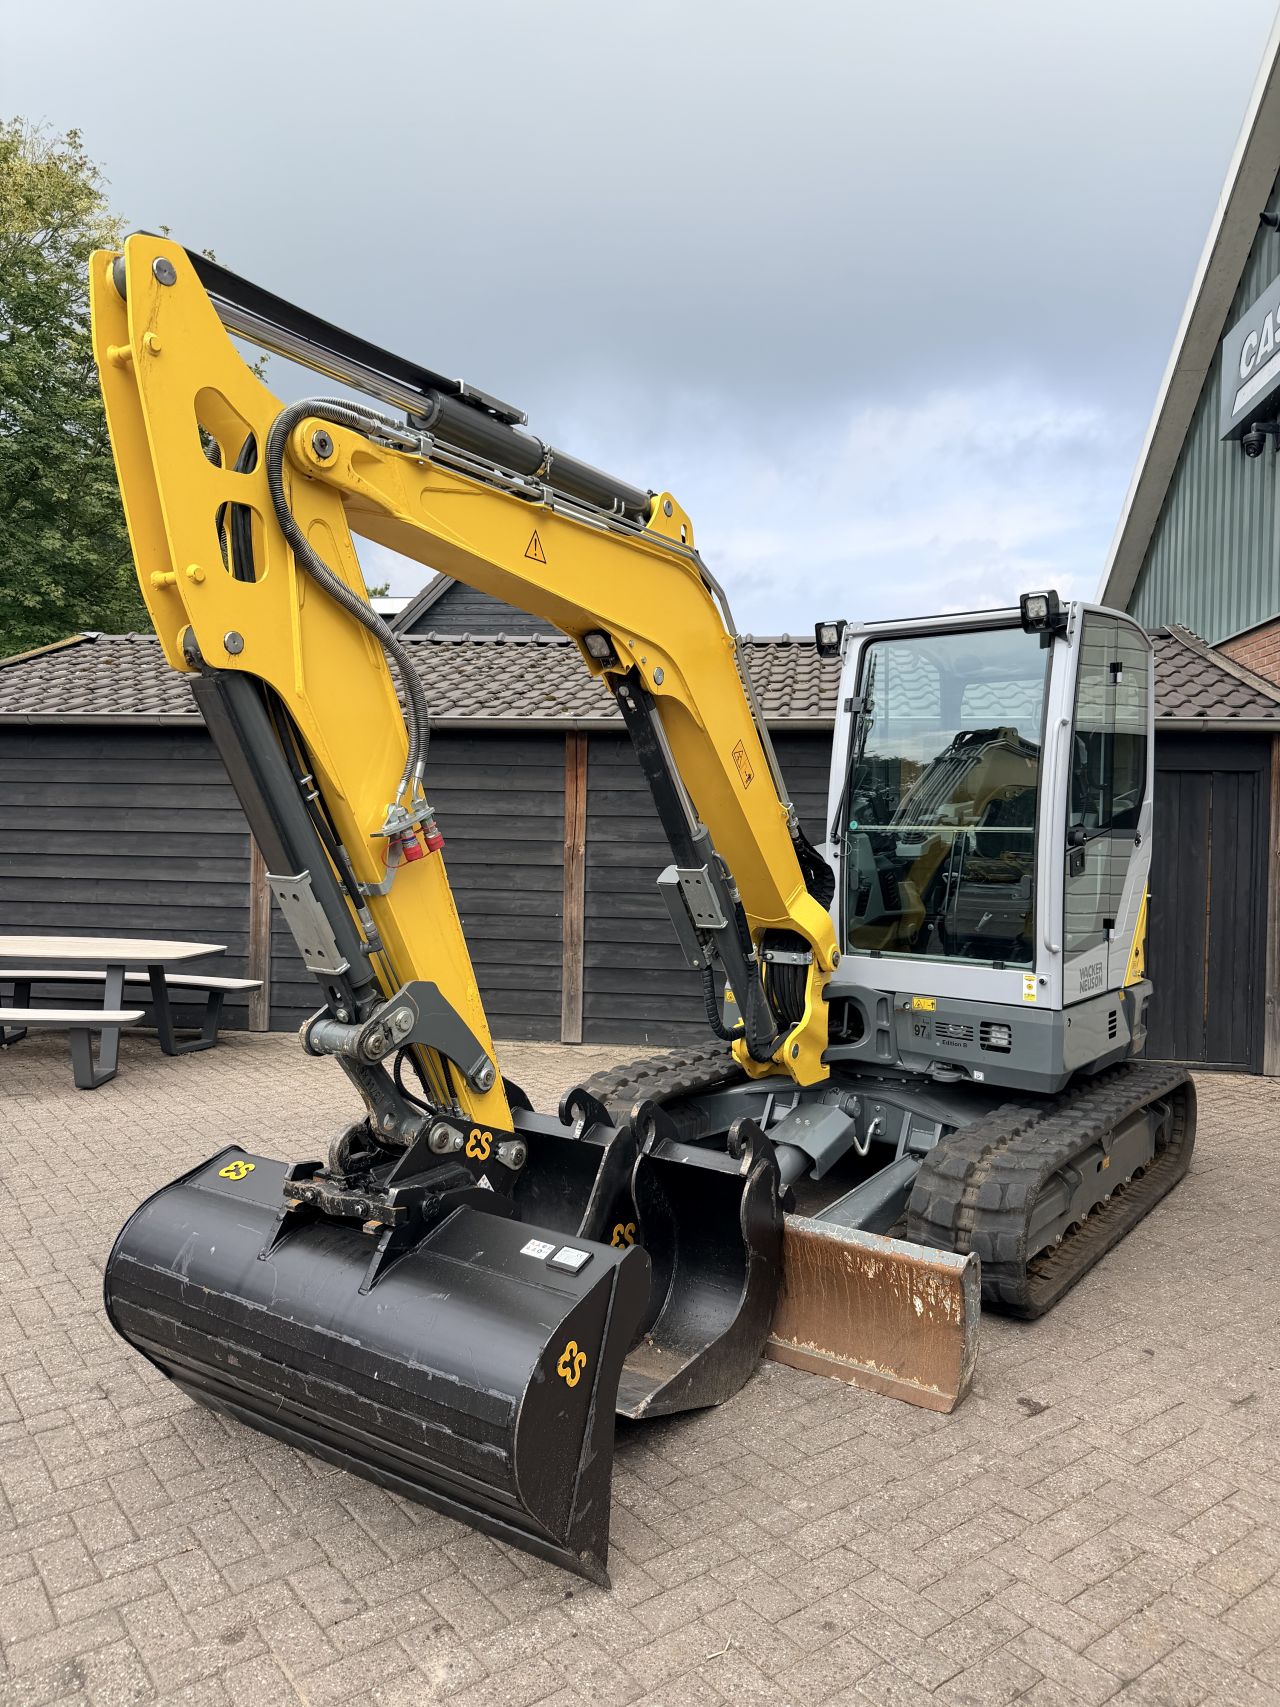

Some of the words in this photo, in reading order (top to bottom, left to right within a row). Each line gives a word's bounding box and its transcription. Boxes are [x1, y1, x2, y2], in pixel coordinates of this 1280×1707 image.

[1080, 962, 1103, 979] WACKER
[1080, 974, 1103, 993] NEUSON
[914, 1024, 926, 1037] 97
